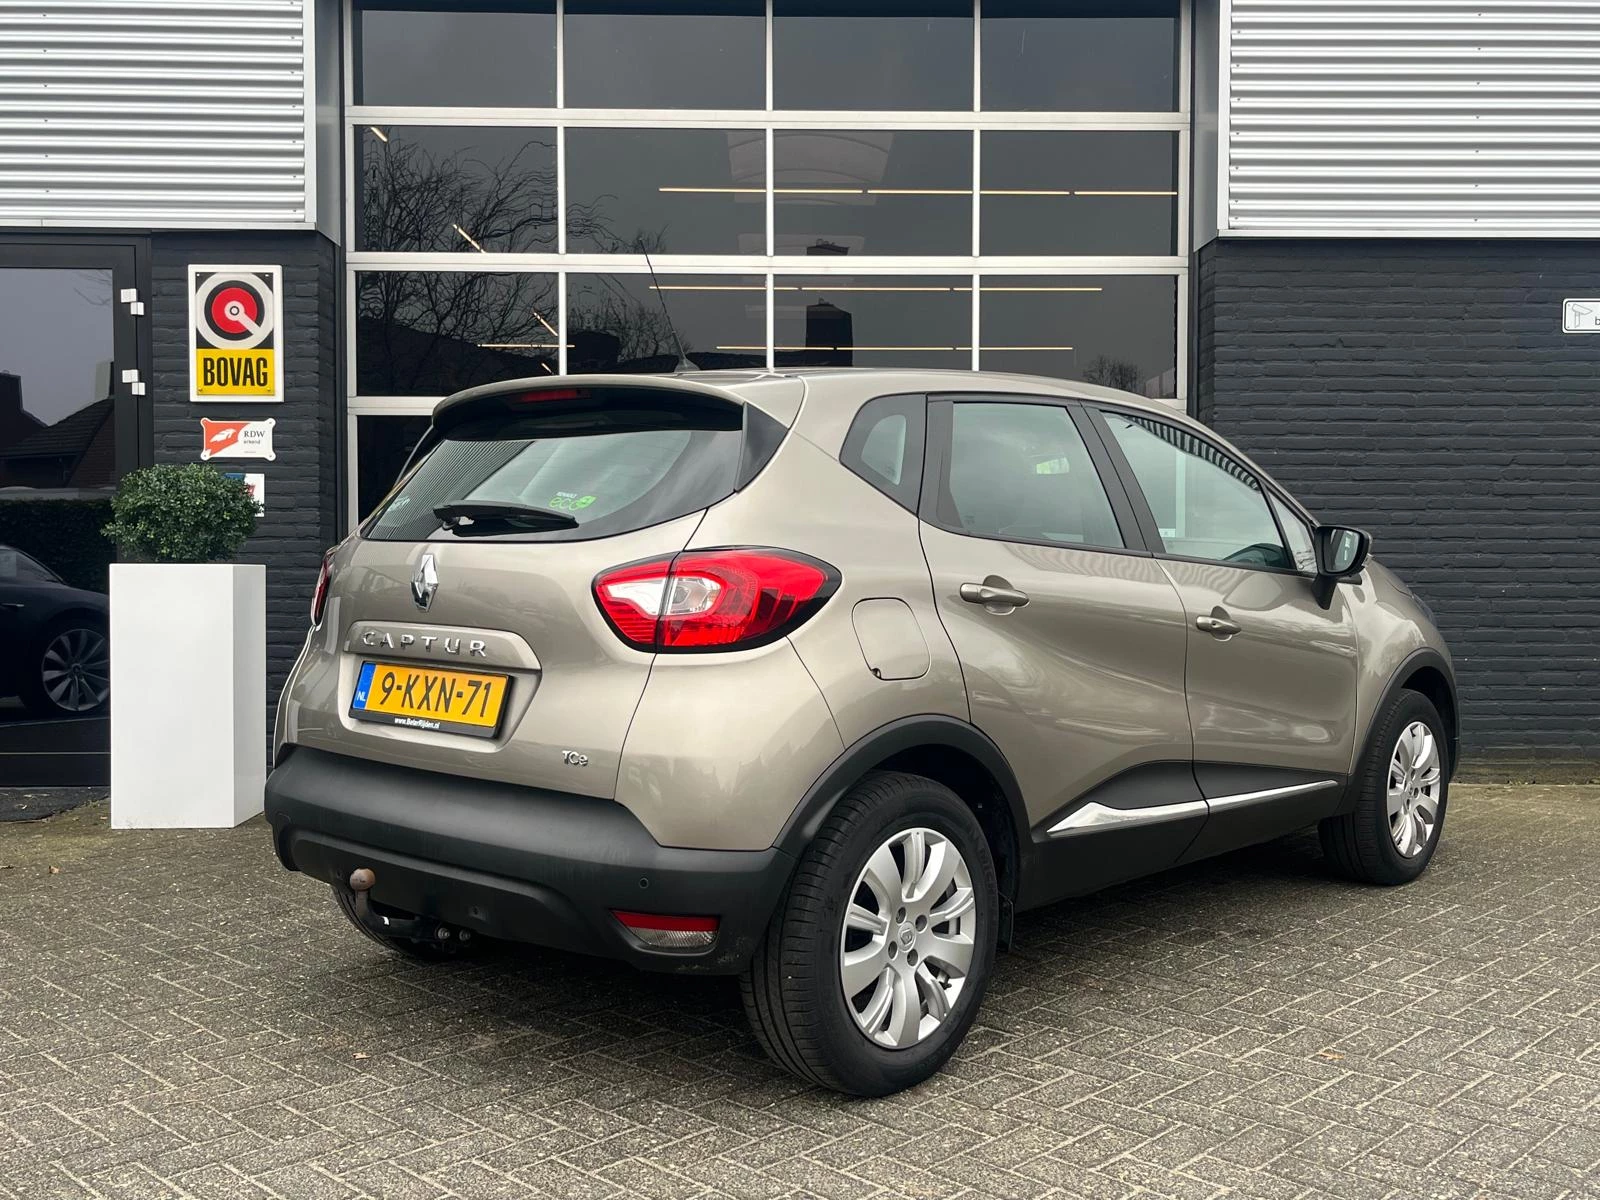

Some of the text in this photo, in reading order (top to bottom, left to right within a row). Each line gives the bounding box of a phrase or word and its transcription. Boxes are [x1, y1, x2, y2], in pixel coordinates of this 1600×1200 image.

[203, 357, 268, 387] BOVAG
[244, 430, 266, 438] RDW
[362, 631, 487, 657] CAPTUR
[356, 691, 366, 702] NL
[379, 672, 492, 718] 9-KXN-71
[562, 750, 589, 766] TCe
